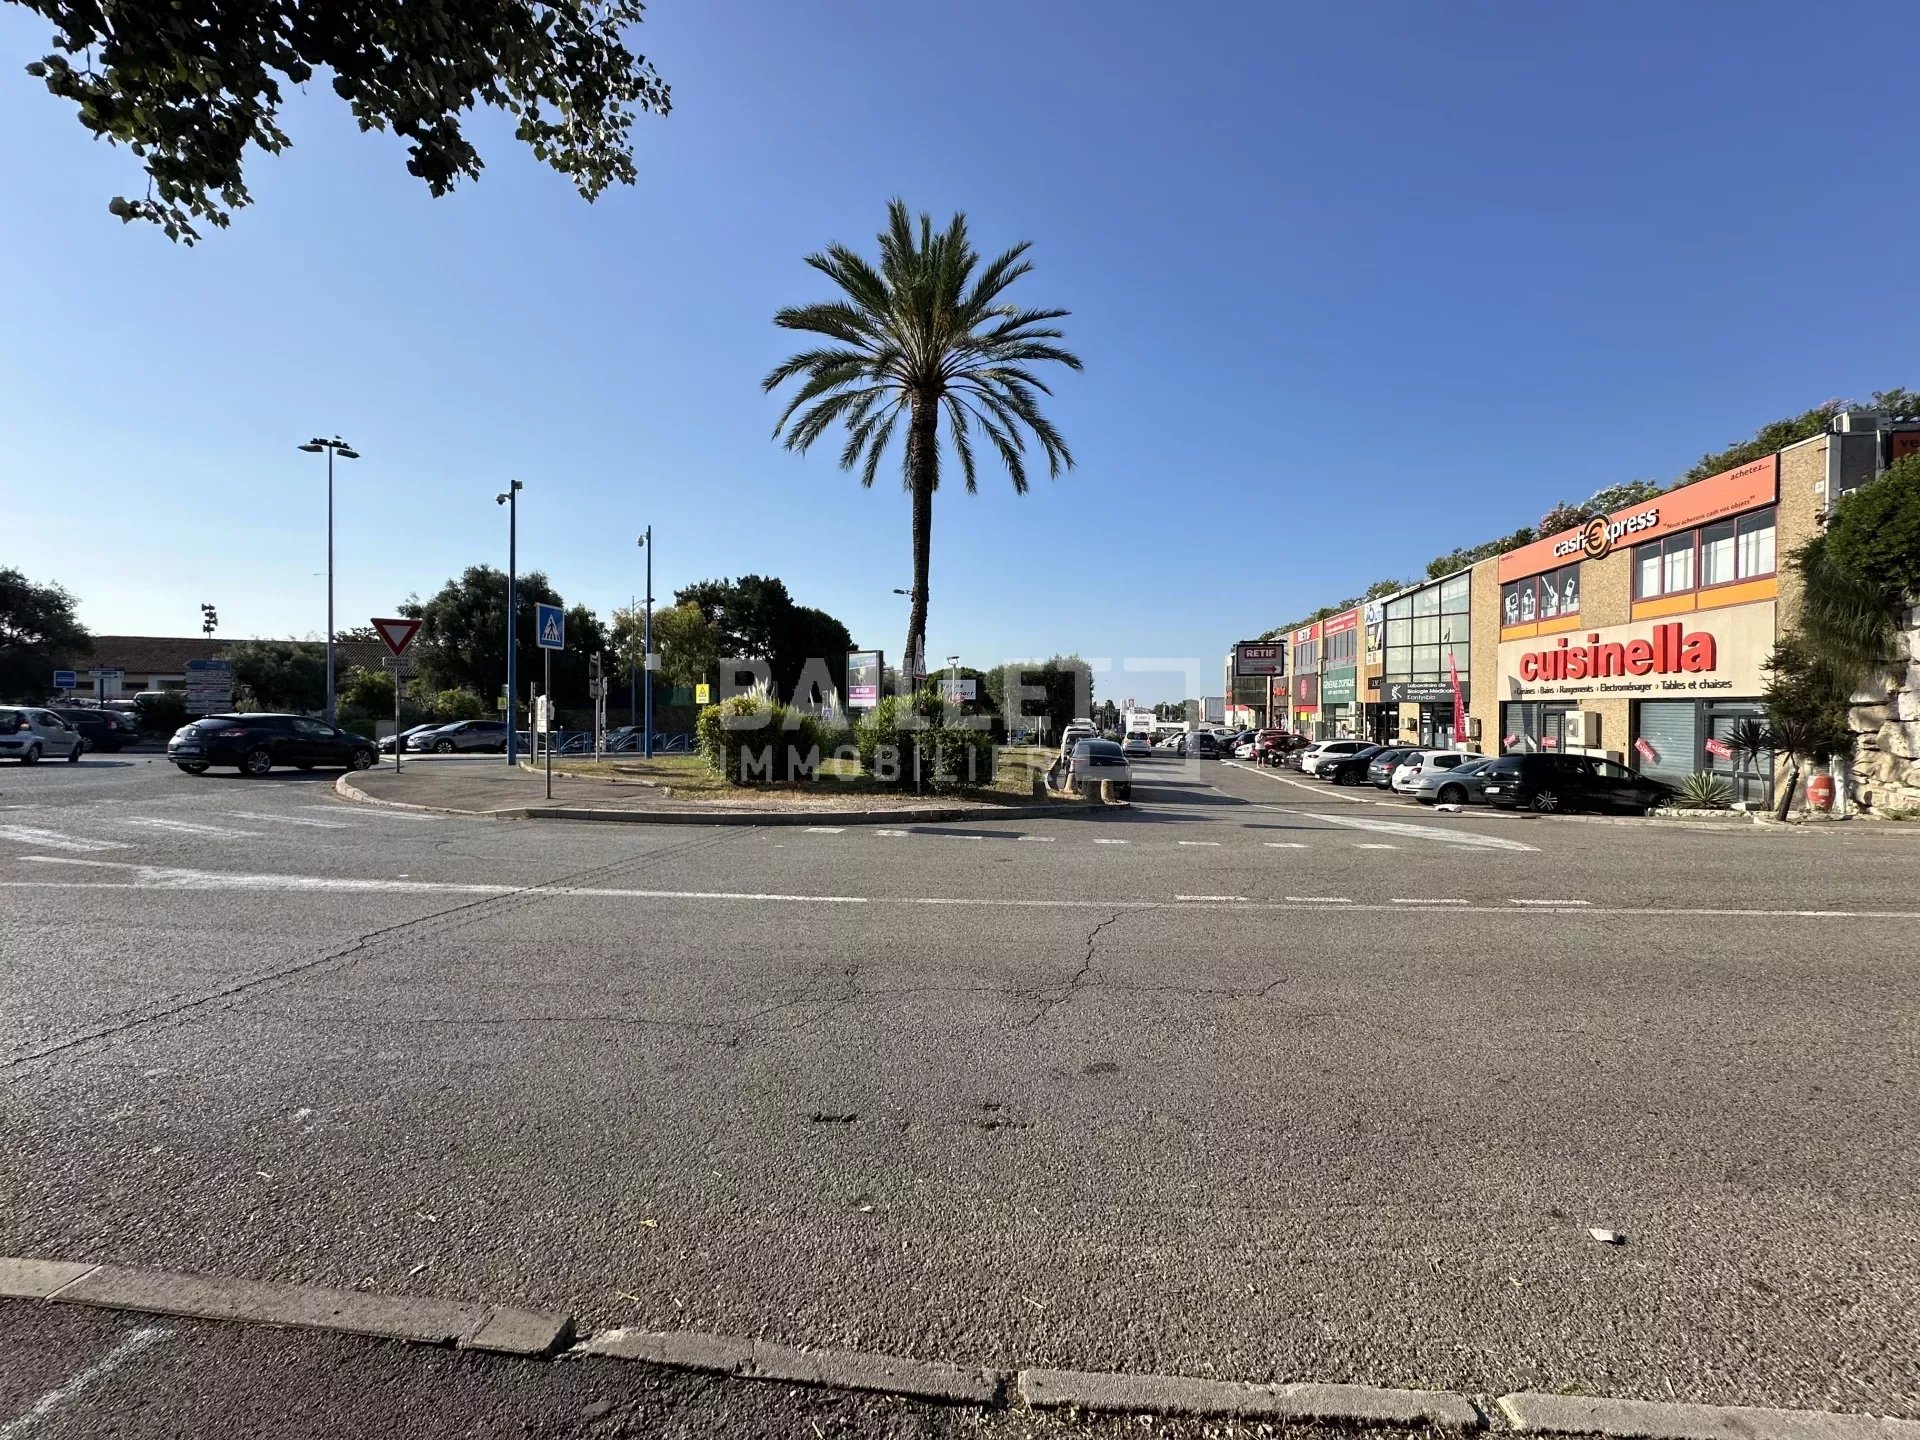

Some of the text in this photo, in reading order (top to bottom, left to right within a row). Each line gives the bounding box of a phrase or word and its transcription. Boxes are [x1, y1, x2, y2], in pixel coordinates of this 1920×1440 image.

[1681, 513, 1705, 525] achetons
[1706, 509, 1719, 518] cash
[1719, 506, 1730, 514] vos
[1245, 649, 1276, 658] RETIF
[1519, 621, 1718, 683] cuisinella
[1540, 686, 1554, 694] Bains
[1559, 685, 1594, 696] Rangements
[1600, 682, 1652, 693] Electroménager
[1661, 680, 1686, 690] Tables
[1688, 680, 1697, 689] et
[1699, 679, 1733, 689] chaises
